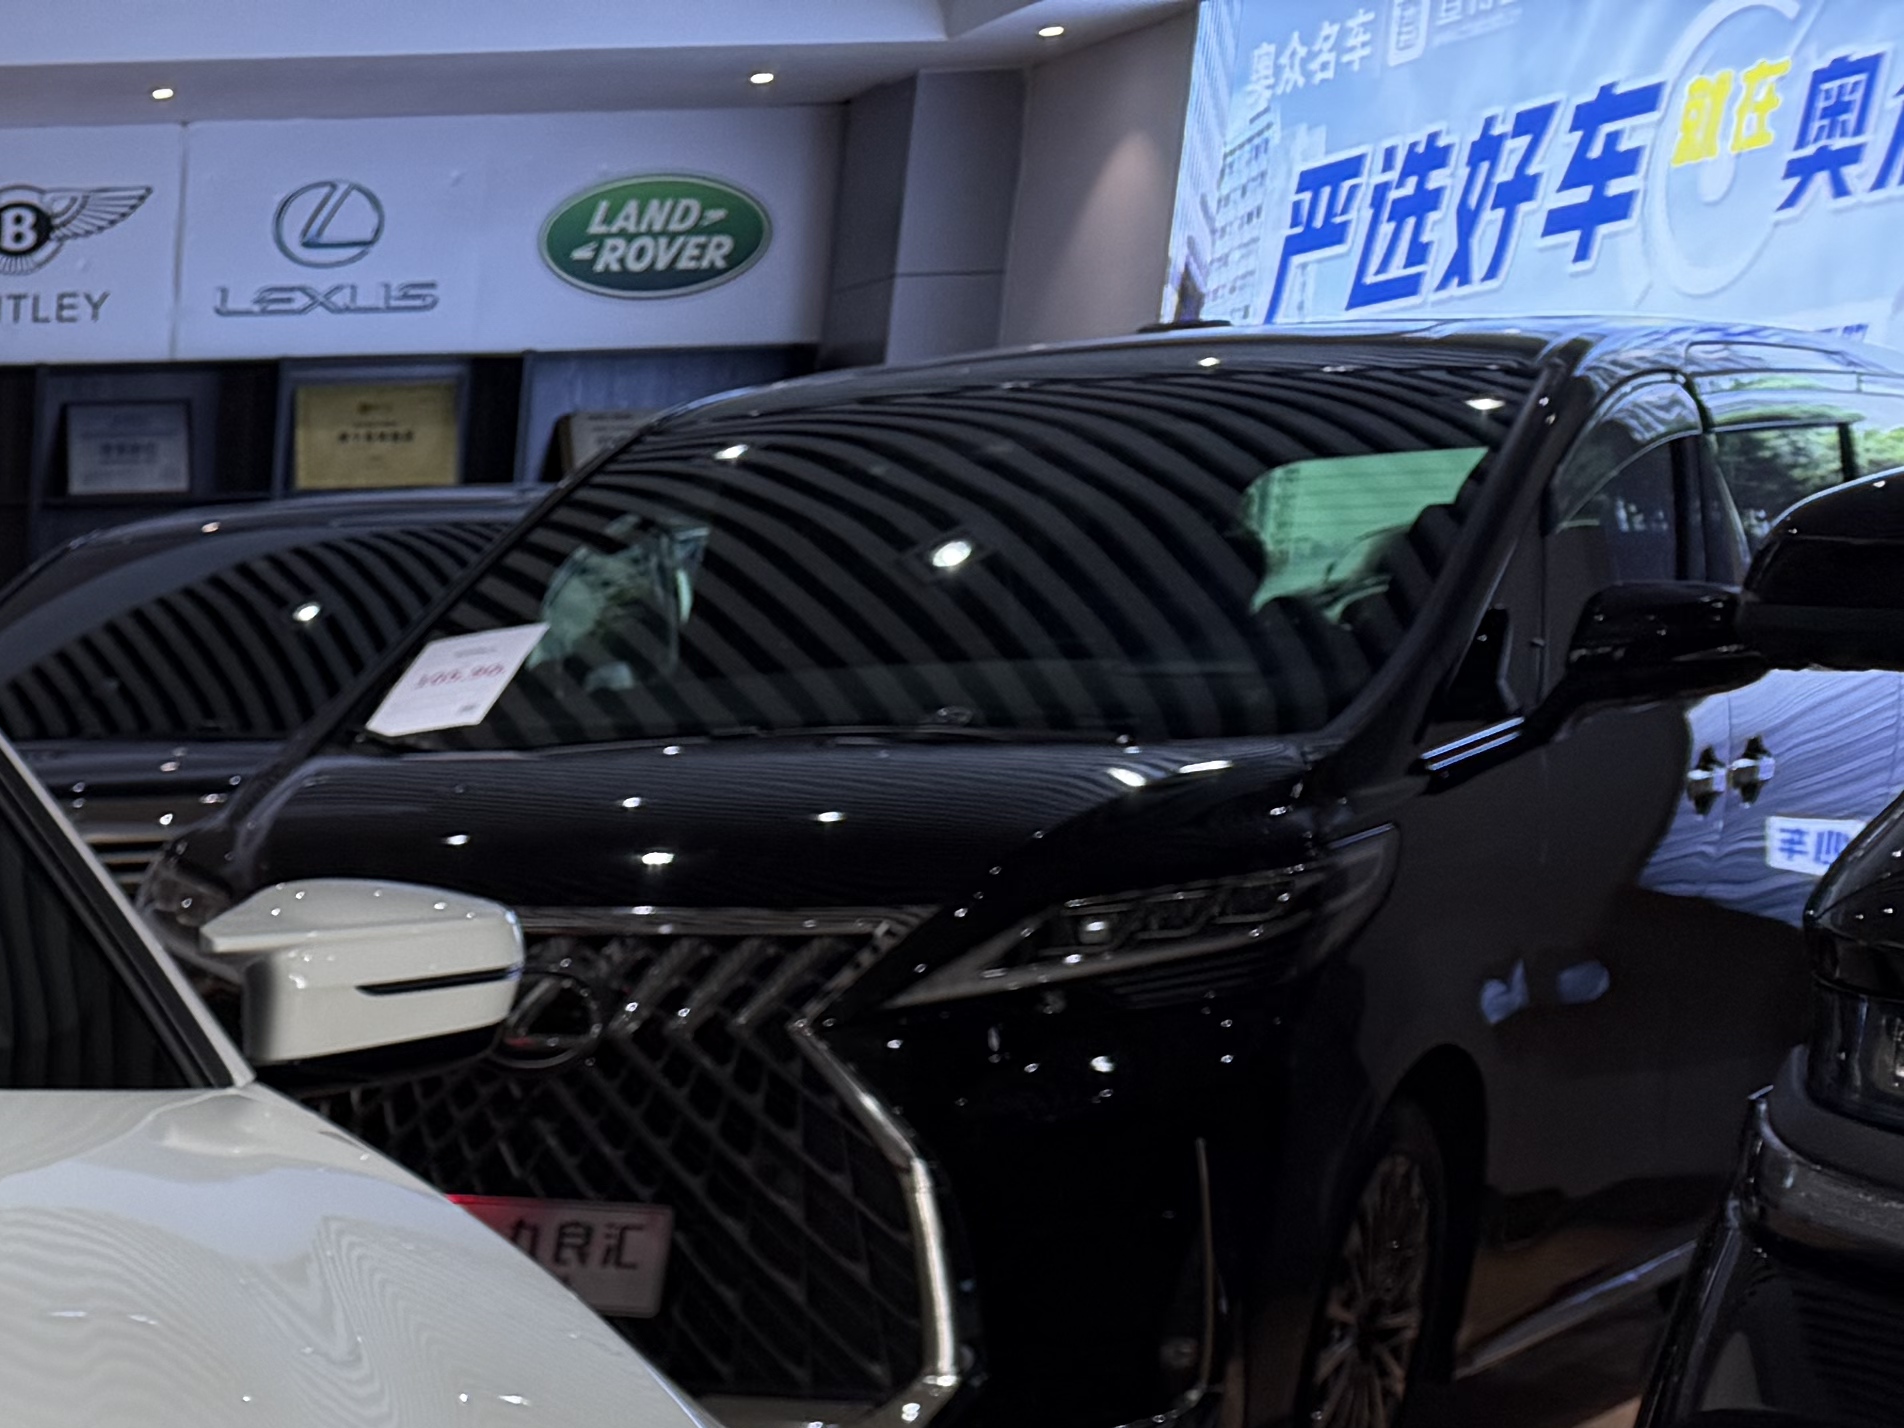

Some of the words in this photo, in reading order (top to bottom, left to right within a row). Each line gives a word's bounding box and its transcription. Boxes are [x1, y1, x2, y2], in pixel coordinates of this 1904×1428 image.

[1245, 8, 1376, 111] 奥众名车
[586, 200, 702, 235] LAND
[594, 235, 735, 274] ROVER
[214, 281, 439, 317] LEXUS
